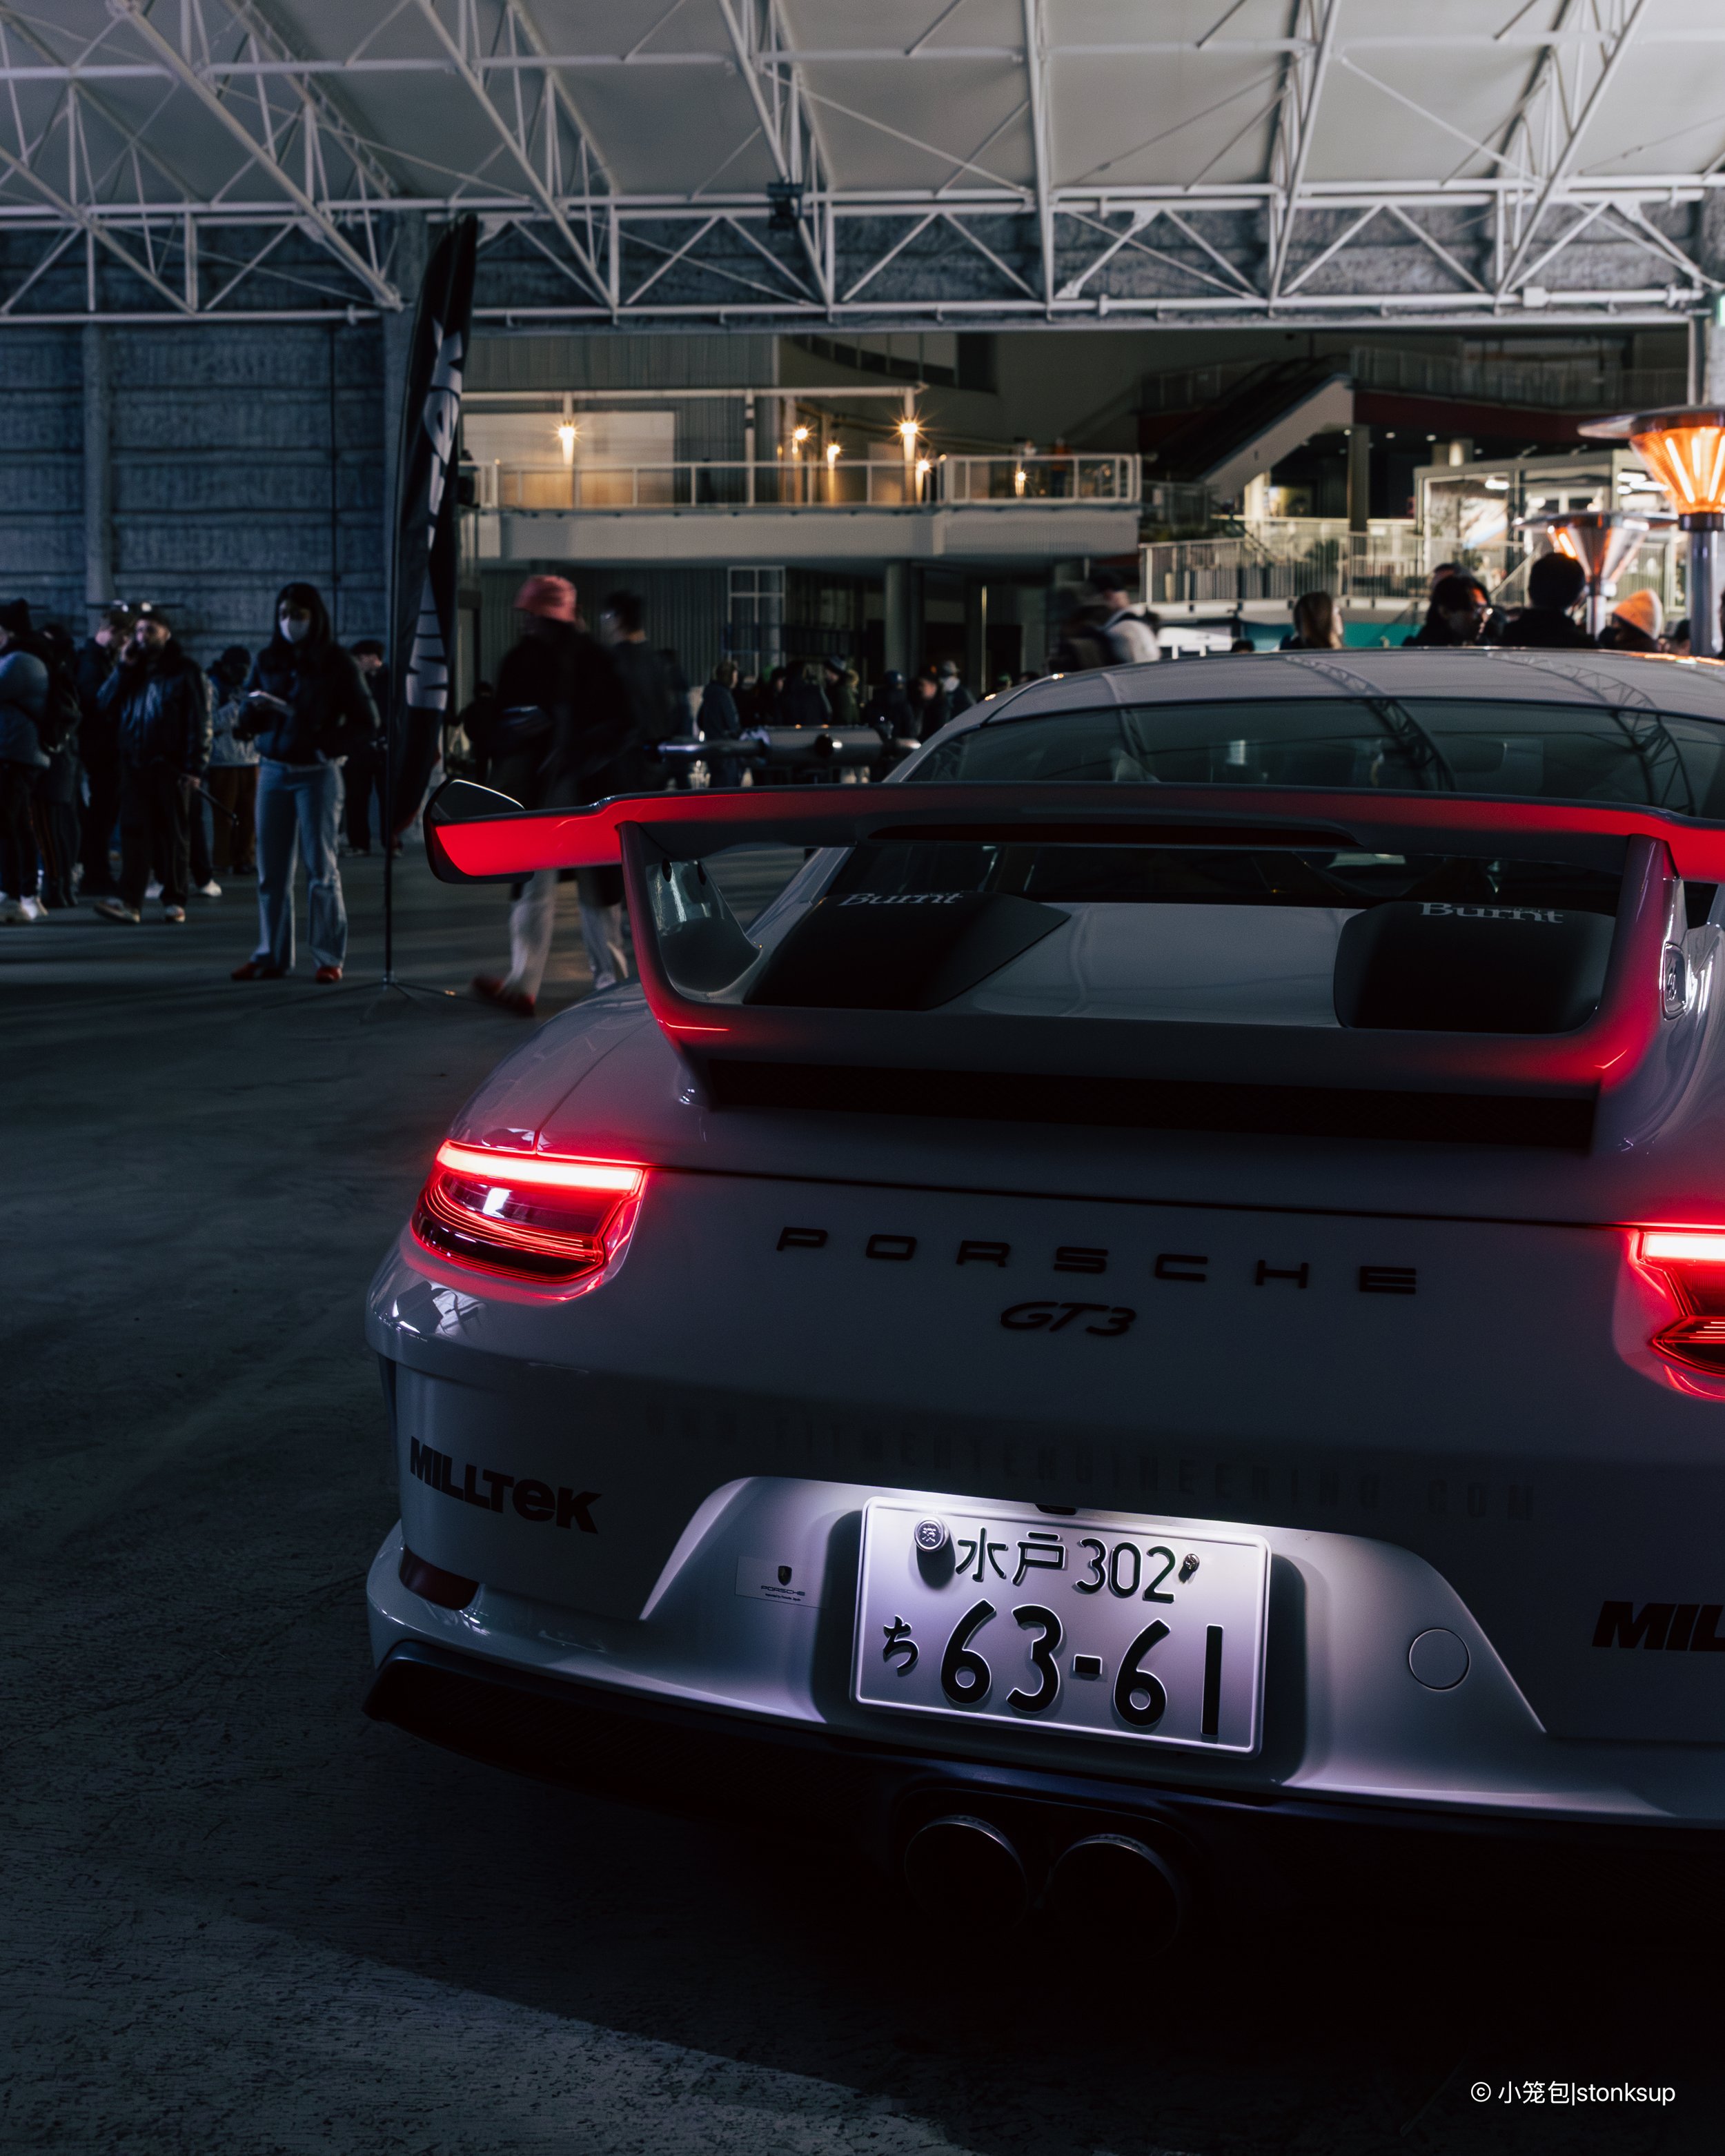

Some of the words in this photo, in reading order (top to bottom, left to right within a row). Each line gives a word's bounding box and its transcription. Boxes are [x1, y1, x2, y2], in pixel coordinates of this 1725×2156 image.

[837, 892, 965, 907] Burnt
[1417, 901, 1564, 924] Burnt
[776, 1227, 1417, 1294] PORSCHE
[1000, 1301, 1136, 1336] GT3
[955, 1526, 1066, 1586] 水戸
[1075, 1537, 1176, 1604] 302
[883, 1615, 919, 1670] ち
[940, 1598, 1224, 1737] 63-61
